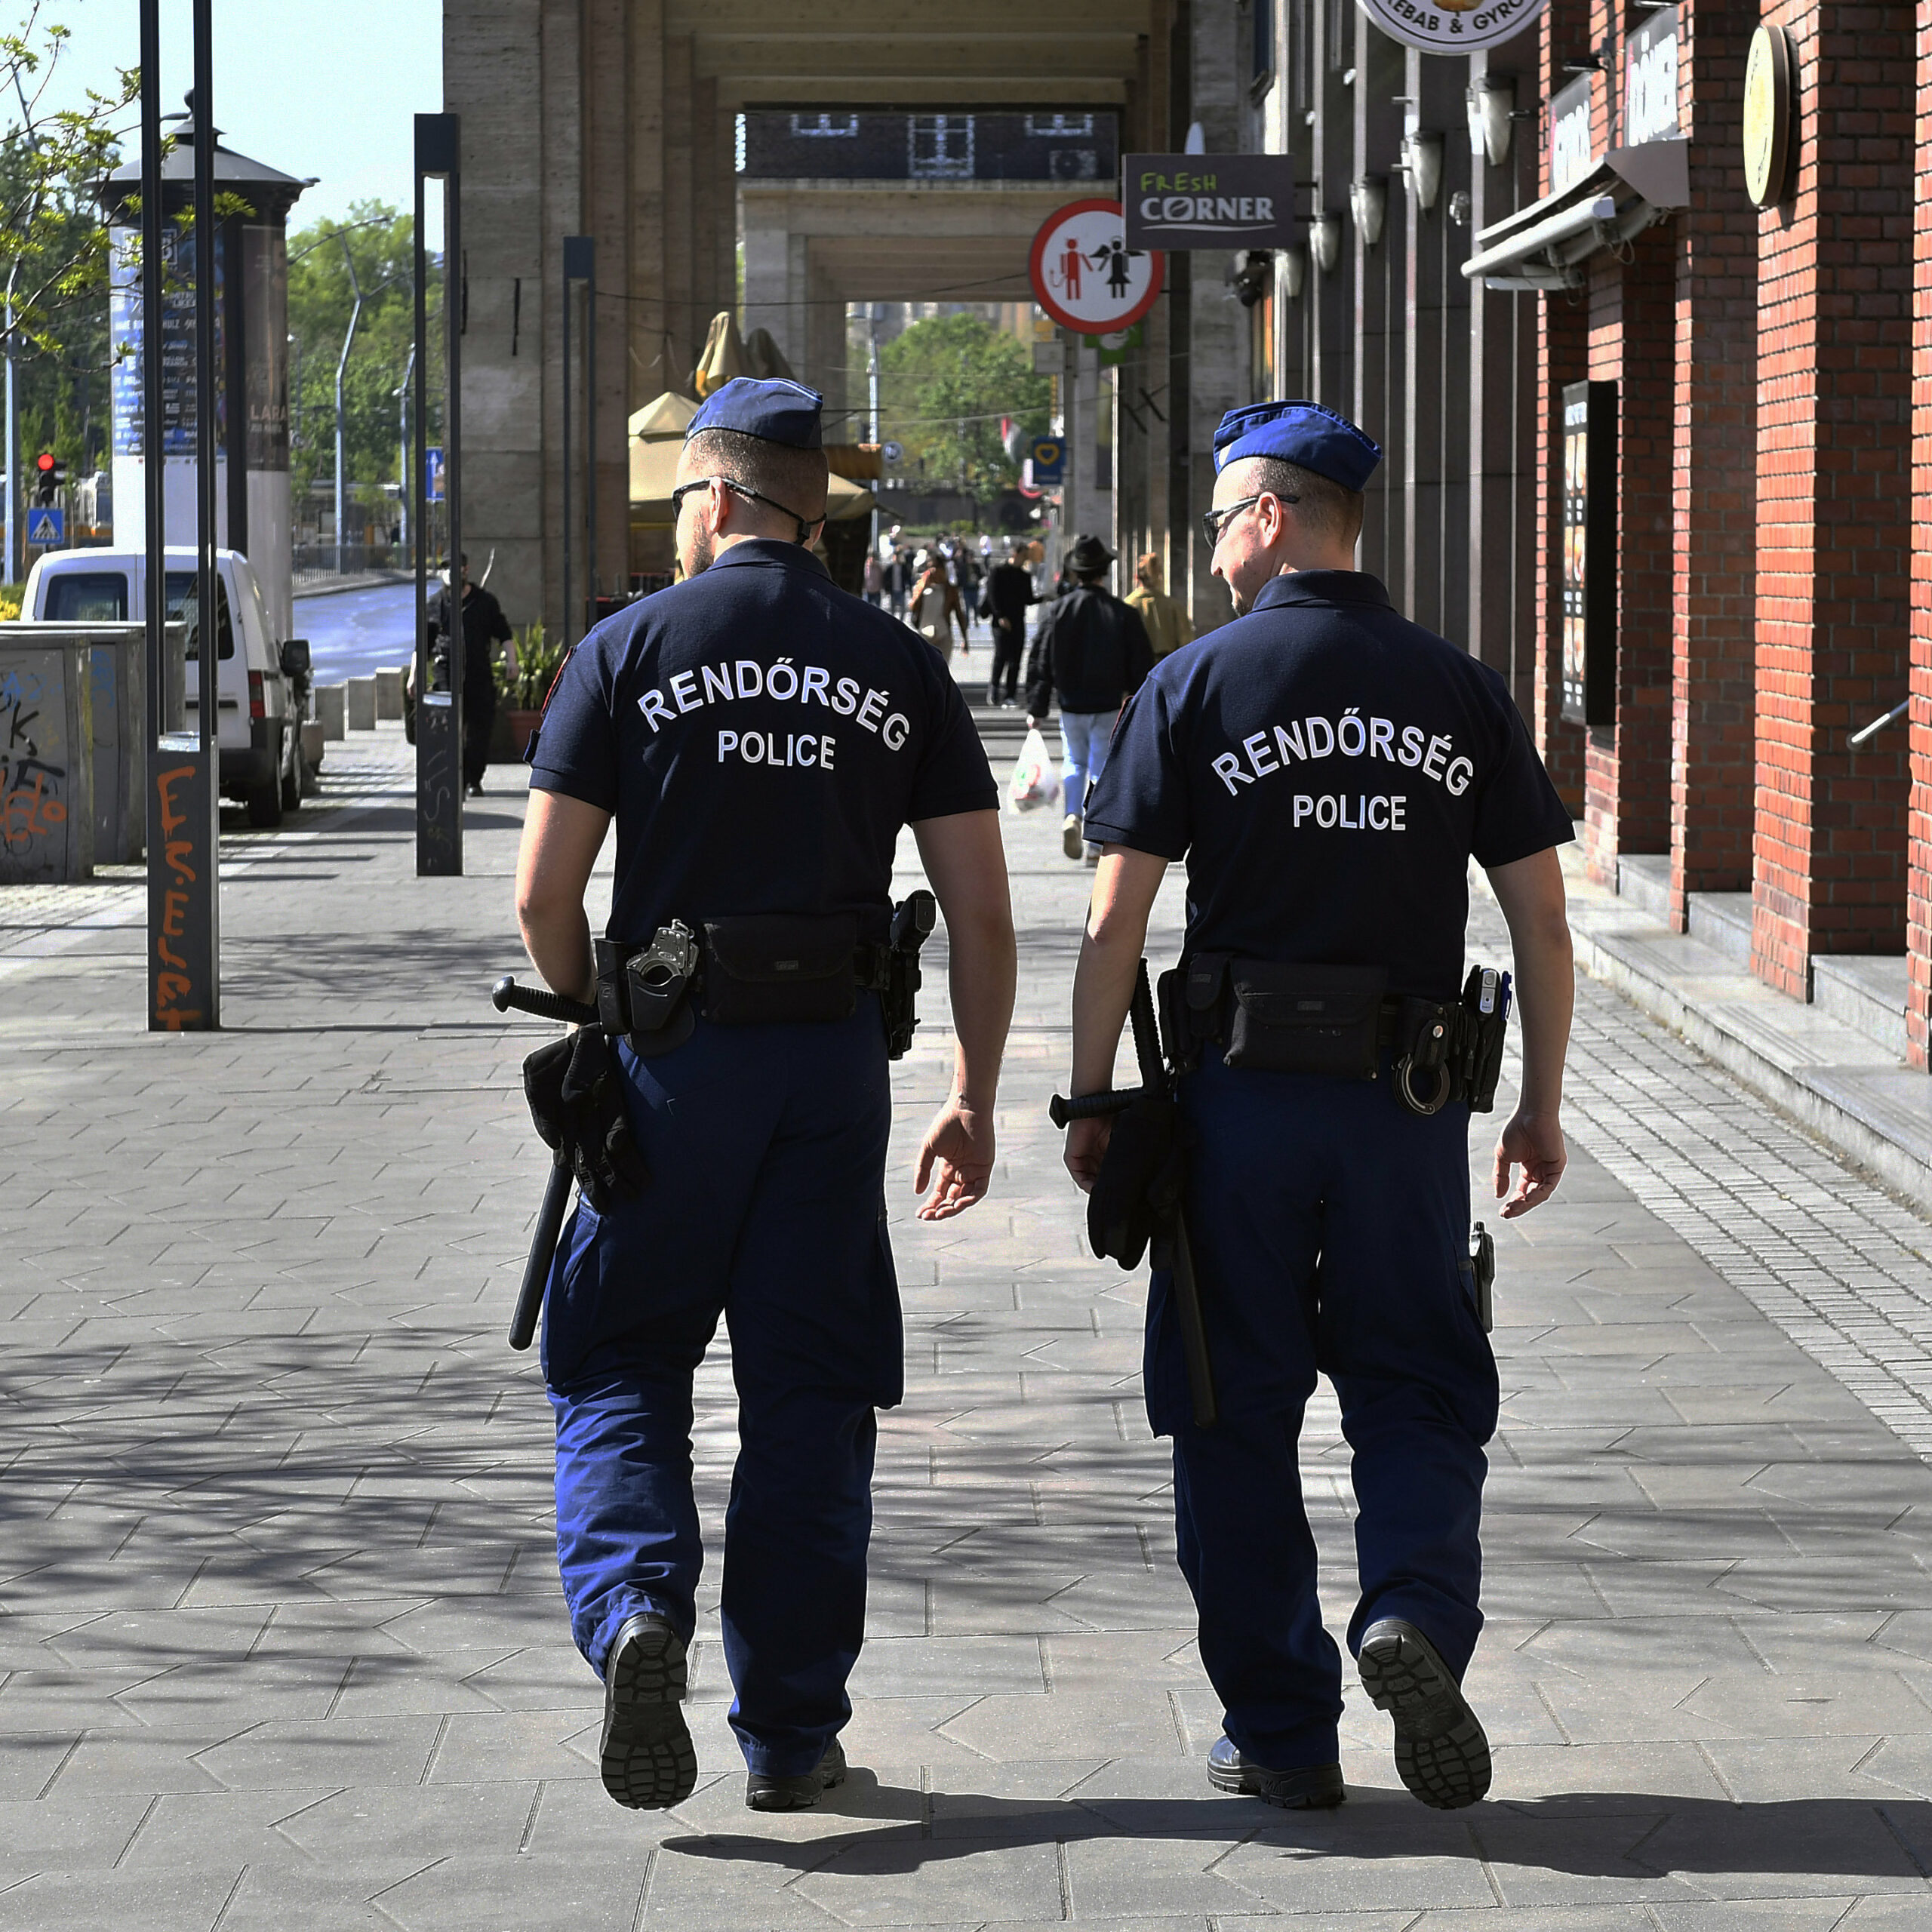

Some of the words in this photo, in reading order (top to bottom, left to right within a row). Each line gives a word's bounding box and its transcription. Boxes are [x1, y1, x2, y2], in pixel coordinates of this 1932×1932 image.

[1387, 0, 1440, 31] EBAB
[1449, 18, 1463, 34] &
[1140, 196, 1275, 221] CORNER
[638, 657, 910, 751] RENDŐRSÉG
[718, 730, 836, 771] POLICE
[1211, 707, 1474, 796] RENDŐRSÉG
[1293, 795, 1407, 830] POLICE
